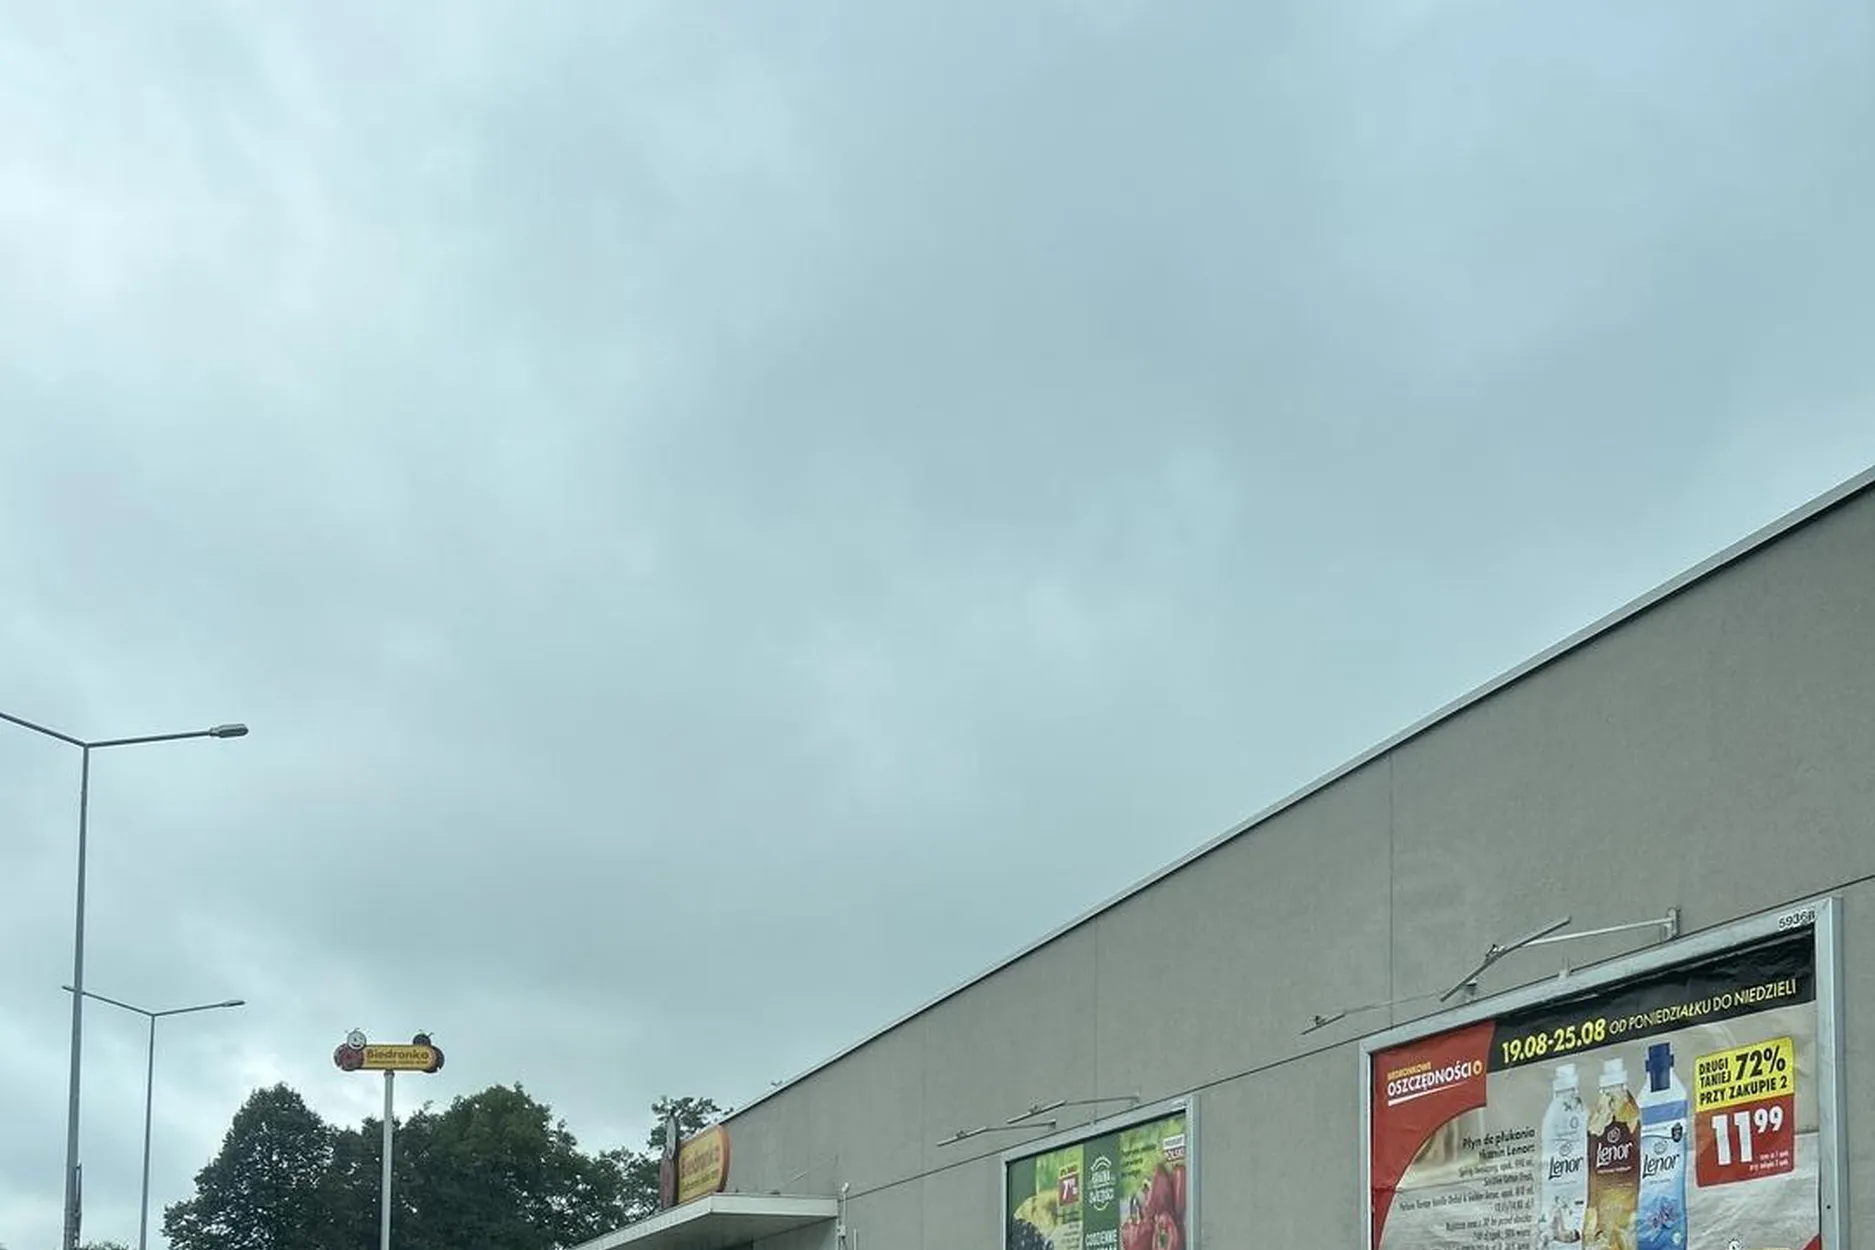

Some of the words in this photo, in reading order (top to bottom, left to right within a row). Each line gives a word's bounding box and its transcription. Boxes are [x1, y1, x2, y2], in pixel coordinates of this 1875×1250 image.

[1502, 1018, 1606, 1063] 19.08-25.08
[1608, 1019, 1627, 1035] OD
[1628, 999, 1712, 1030] PONIEDZIAŁKU
[1712, 993, 1732, 1012] DO
[1734, 979, 1797, 1005] NIEDZIELI
[366, 1047, 430, 1060] Biedronka
[1699, 1057, 1729, 1076] DRUGI
[1735, 1045, 1786, 1081] 72%
[1387, 1060, 1472, 1097] OSZCZĘDNOŚCI
[1700, 1070, 1732, 1089] TANIEJ
[1700, 1088, 1726, 1105] PRZY
[1729, 1077, 1777, 1100] ZAKUPIE
[1780, 1075, 1788, 1089] 2
[1548, 1155, 1584, 1180] Lenor
[1596, 1141, 1633, 1168] Lenor
[1642, 1152, 1681, 1179] Lenor
